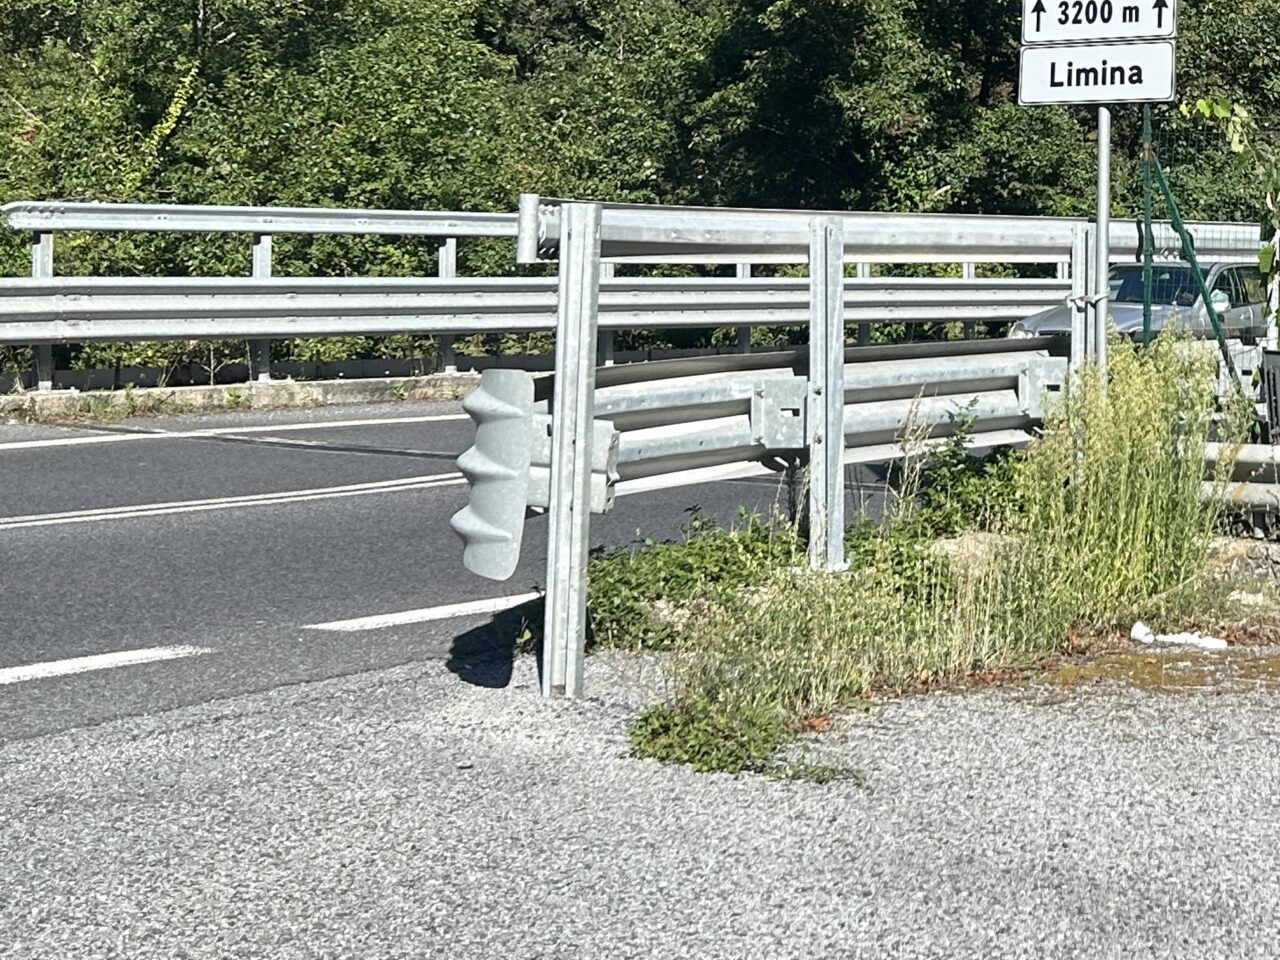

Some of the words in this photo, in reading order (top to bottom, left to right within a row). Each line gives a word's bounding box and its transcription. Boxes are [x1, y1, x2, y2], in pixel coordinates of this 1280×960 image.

[1057, 0, 1113, 25] 3200
[1122, 4, 1140, 24] m
[1049, 59, 1144, 88] Limina
